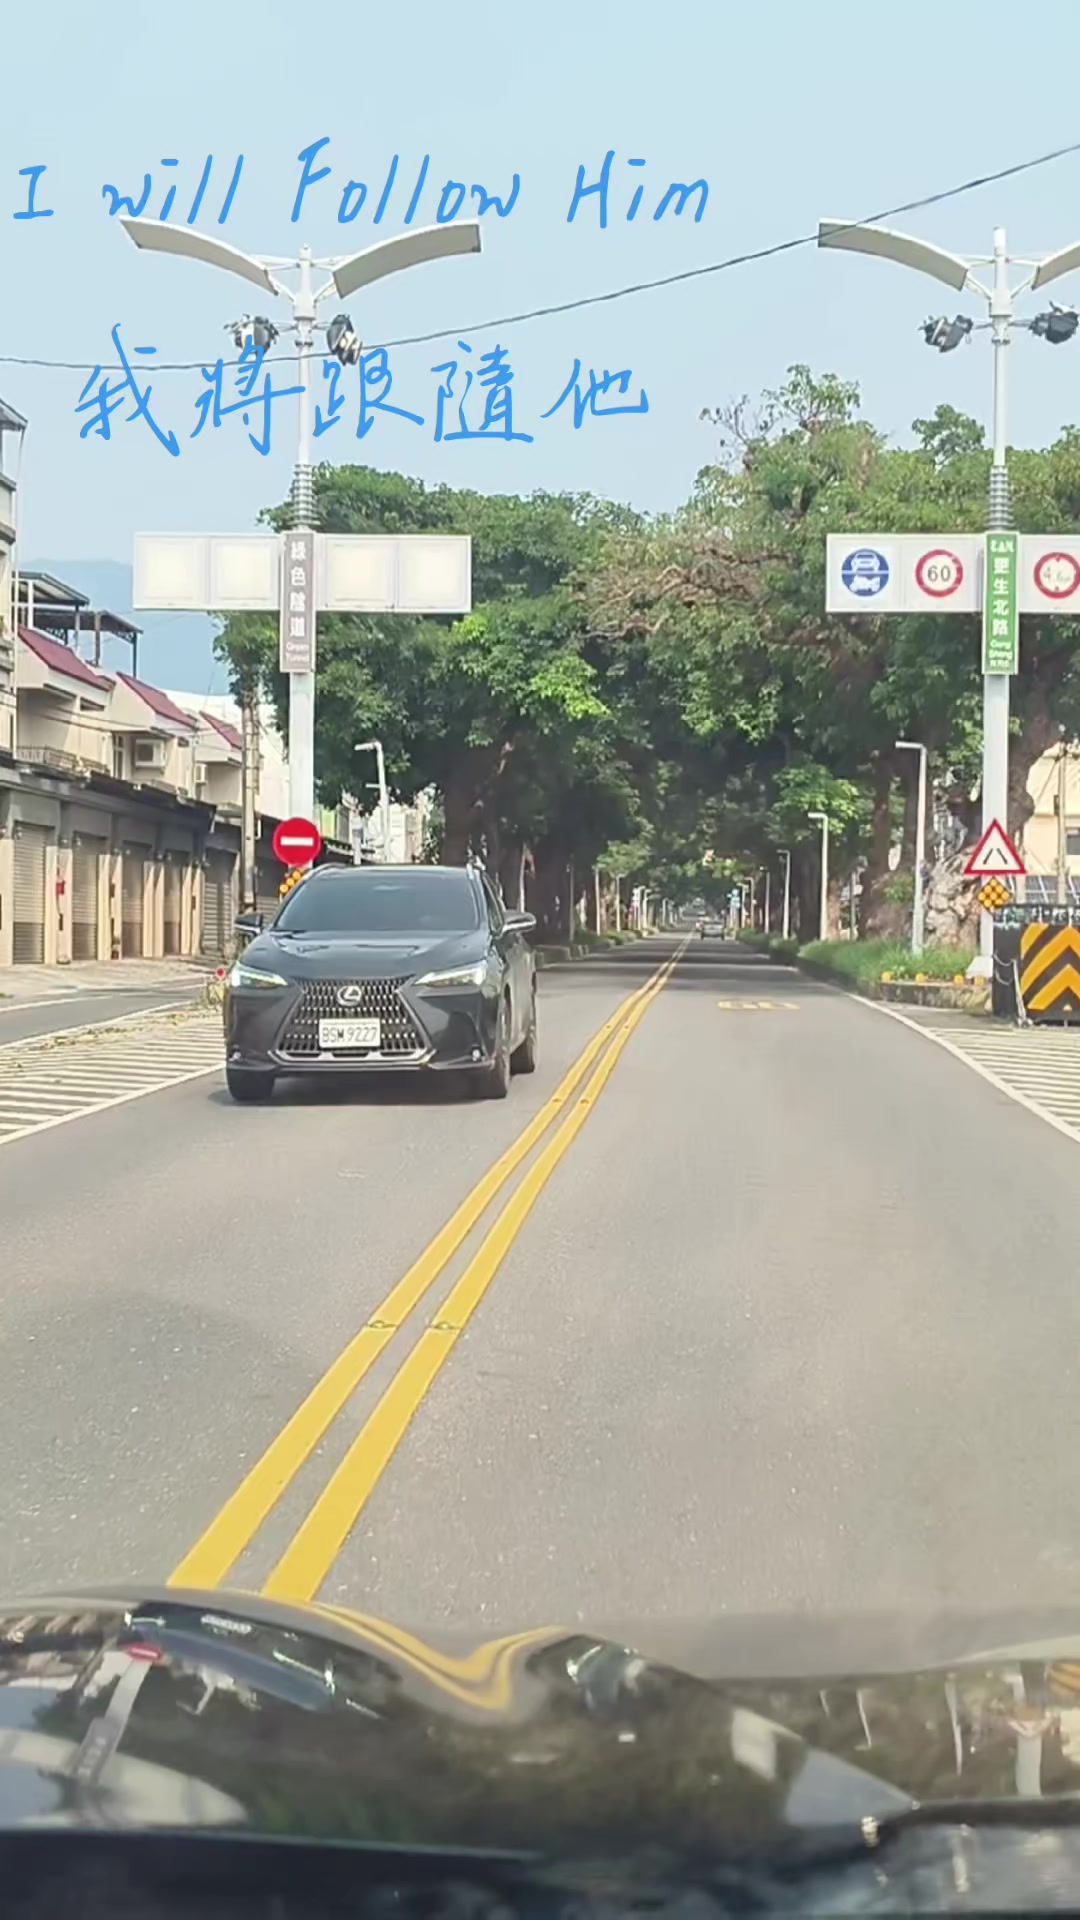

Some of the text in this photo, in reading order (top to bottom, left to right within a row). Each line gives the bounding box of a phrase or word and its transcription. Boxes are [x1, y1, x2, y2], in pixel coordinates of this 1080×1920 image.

[927, 564, 951, 582] 60
[993, 557, 1010, 637] 更生北路
